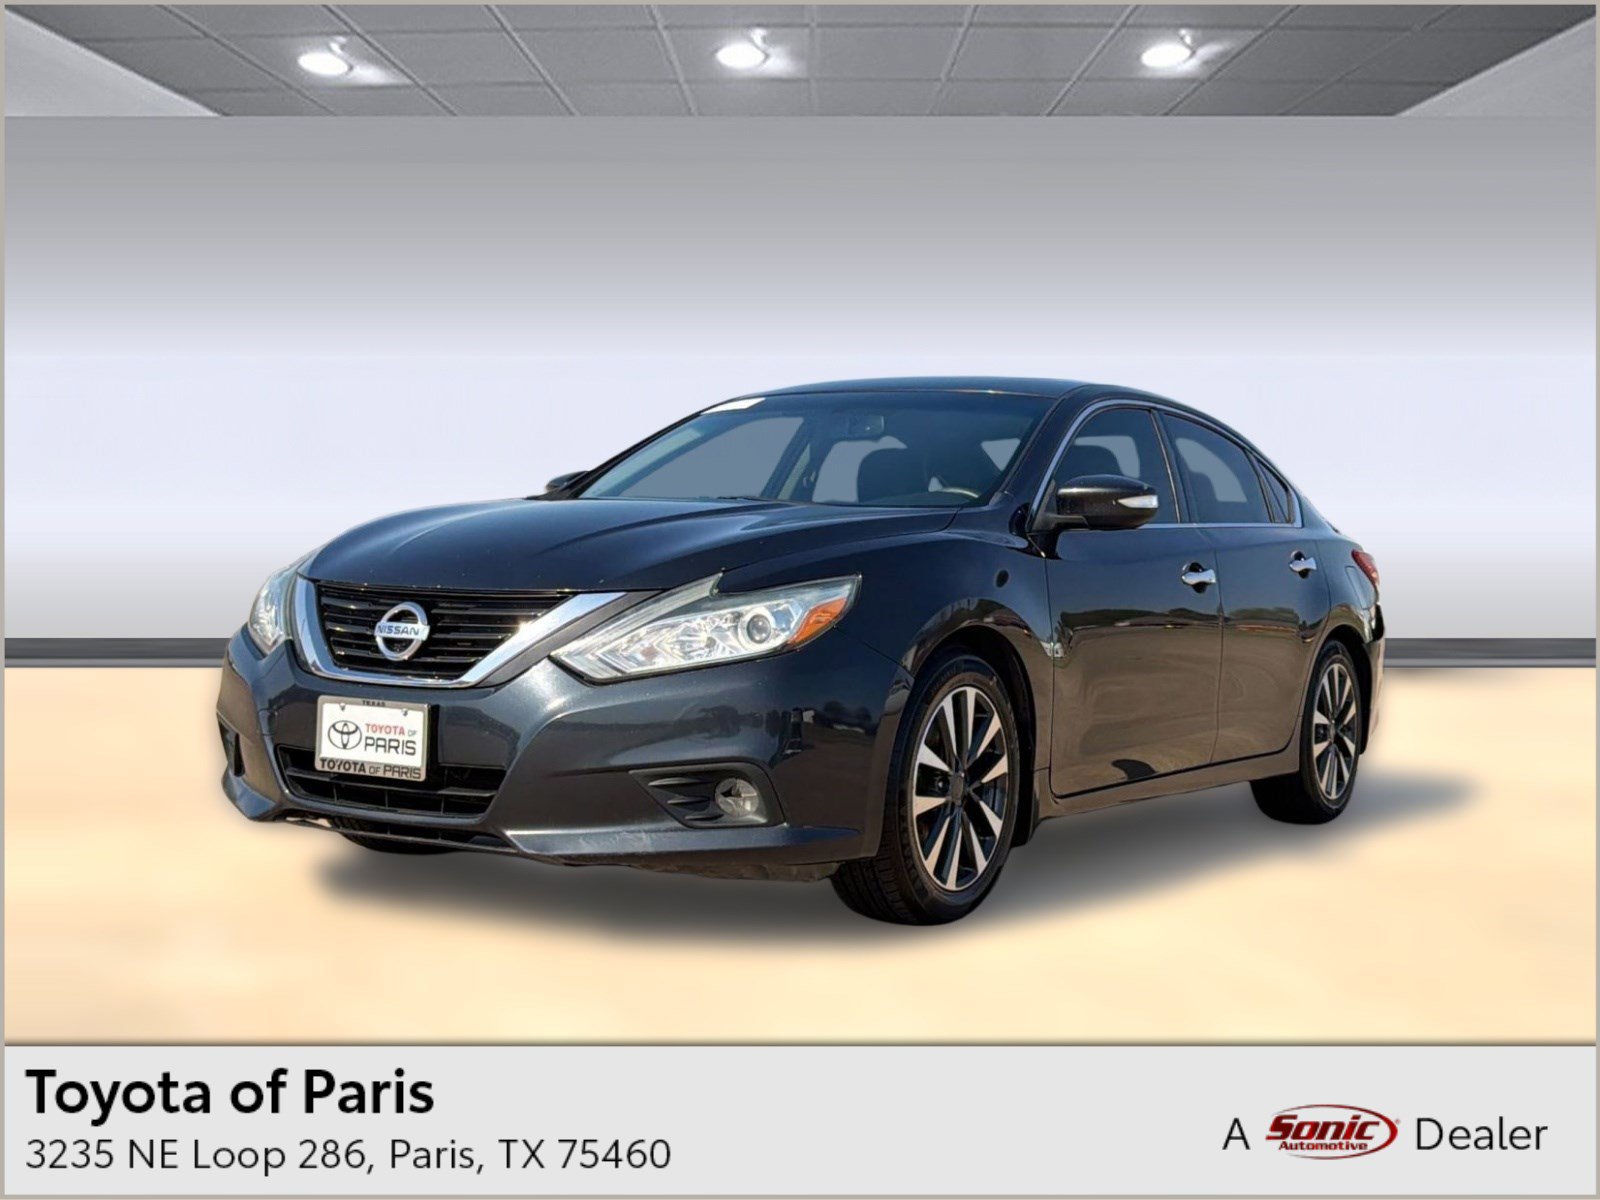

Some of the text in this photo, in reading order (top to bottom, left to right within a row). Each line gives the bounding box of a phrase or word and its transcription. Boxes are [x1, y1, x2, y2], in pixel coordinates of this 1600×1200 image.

[377, 625, 420, 636] NISSAN
[365, 723, 418, 737] TOYOTA OF
[364, 736, 417, 756] PARIS
[320, 758, 421, 780] TOYOTA OF PARIS
